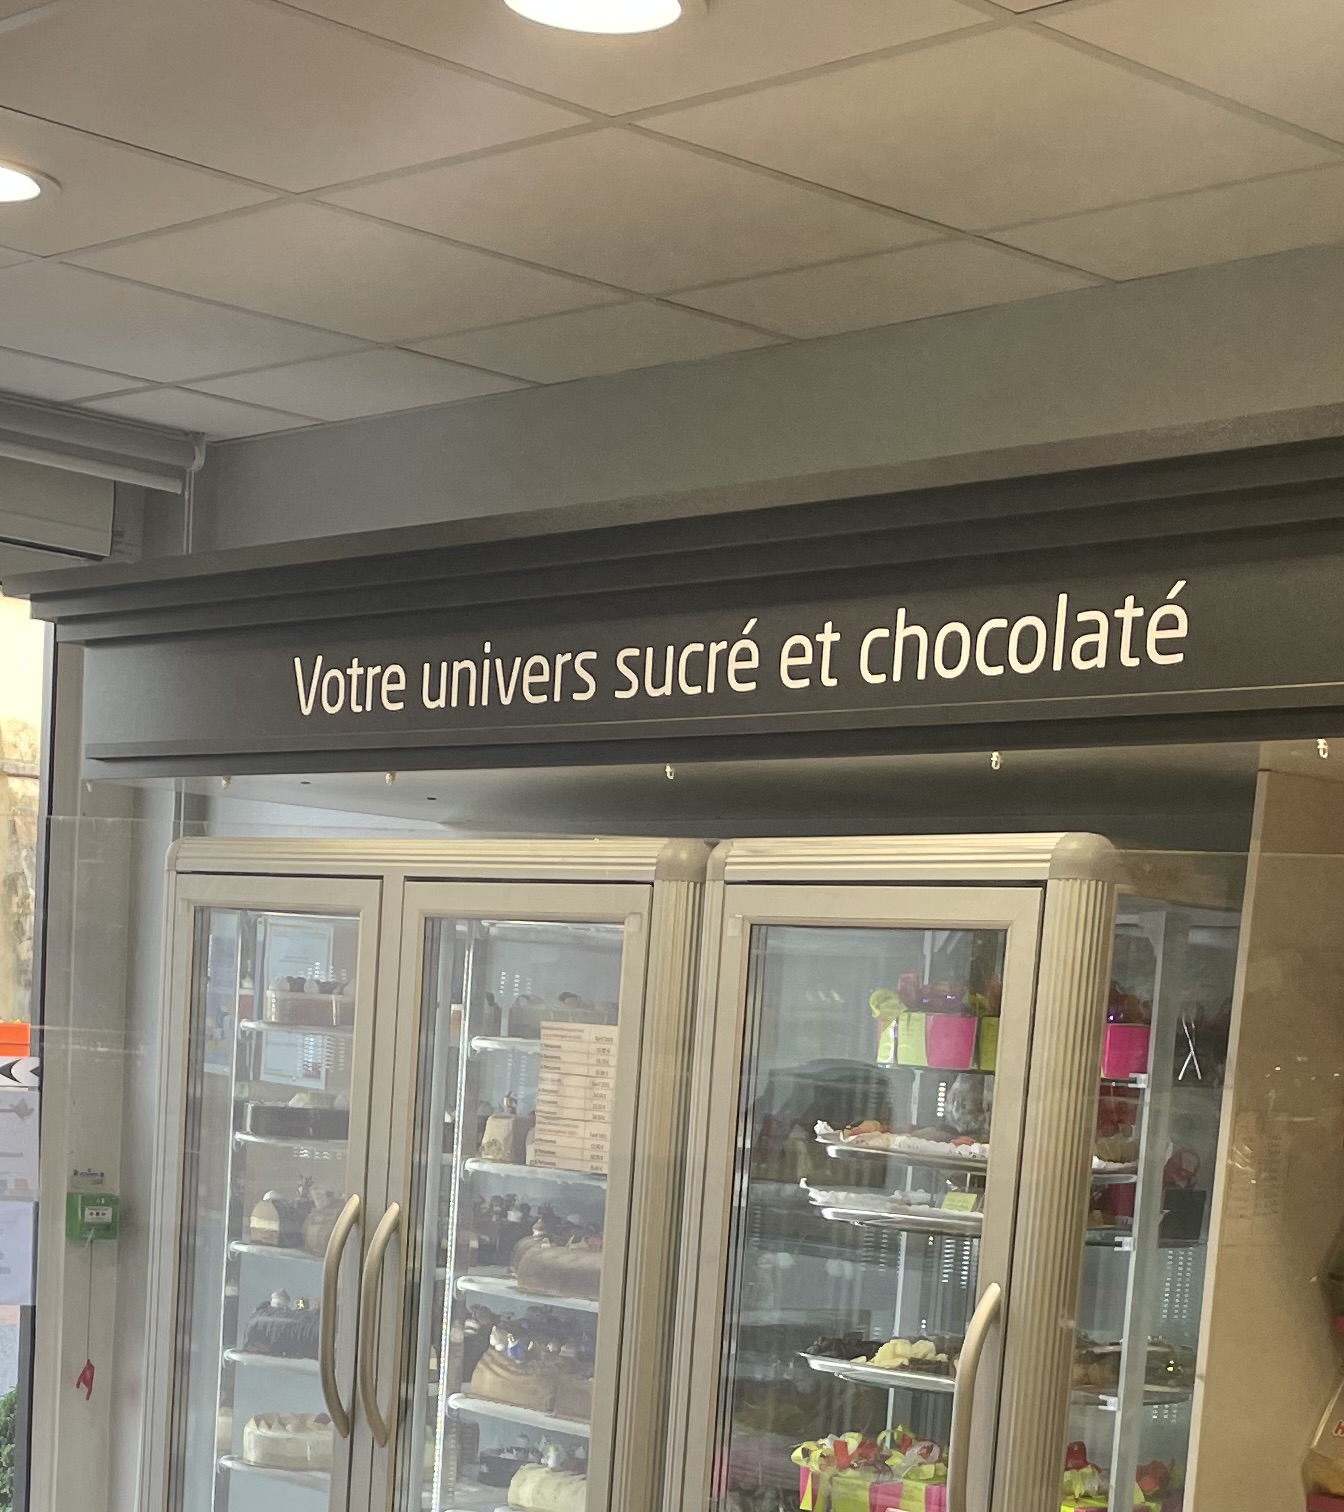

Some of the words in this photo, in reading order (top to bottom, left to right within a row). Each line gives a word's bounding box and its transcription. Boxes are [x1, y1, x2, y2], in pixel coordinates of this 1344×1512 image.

[293, 655, 406, 716] Votre
[422, 642, 598, 709] univers
[614, 617, 759, 699] sucré
[780, 620, 841, 689] et
[859, 580, 1188, 684] chocolaté
